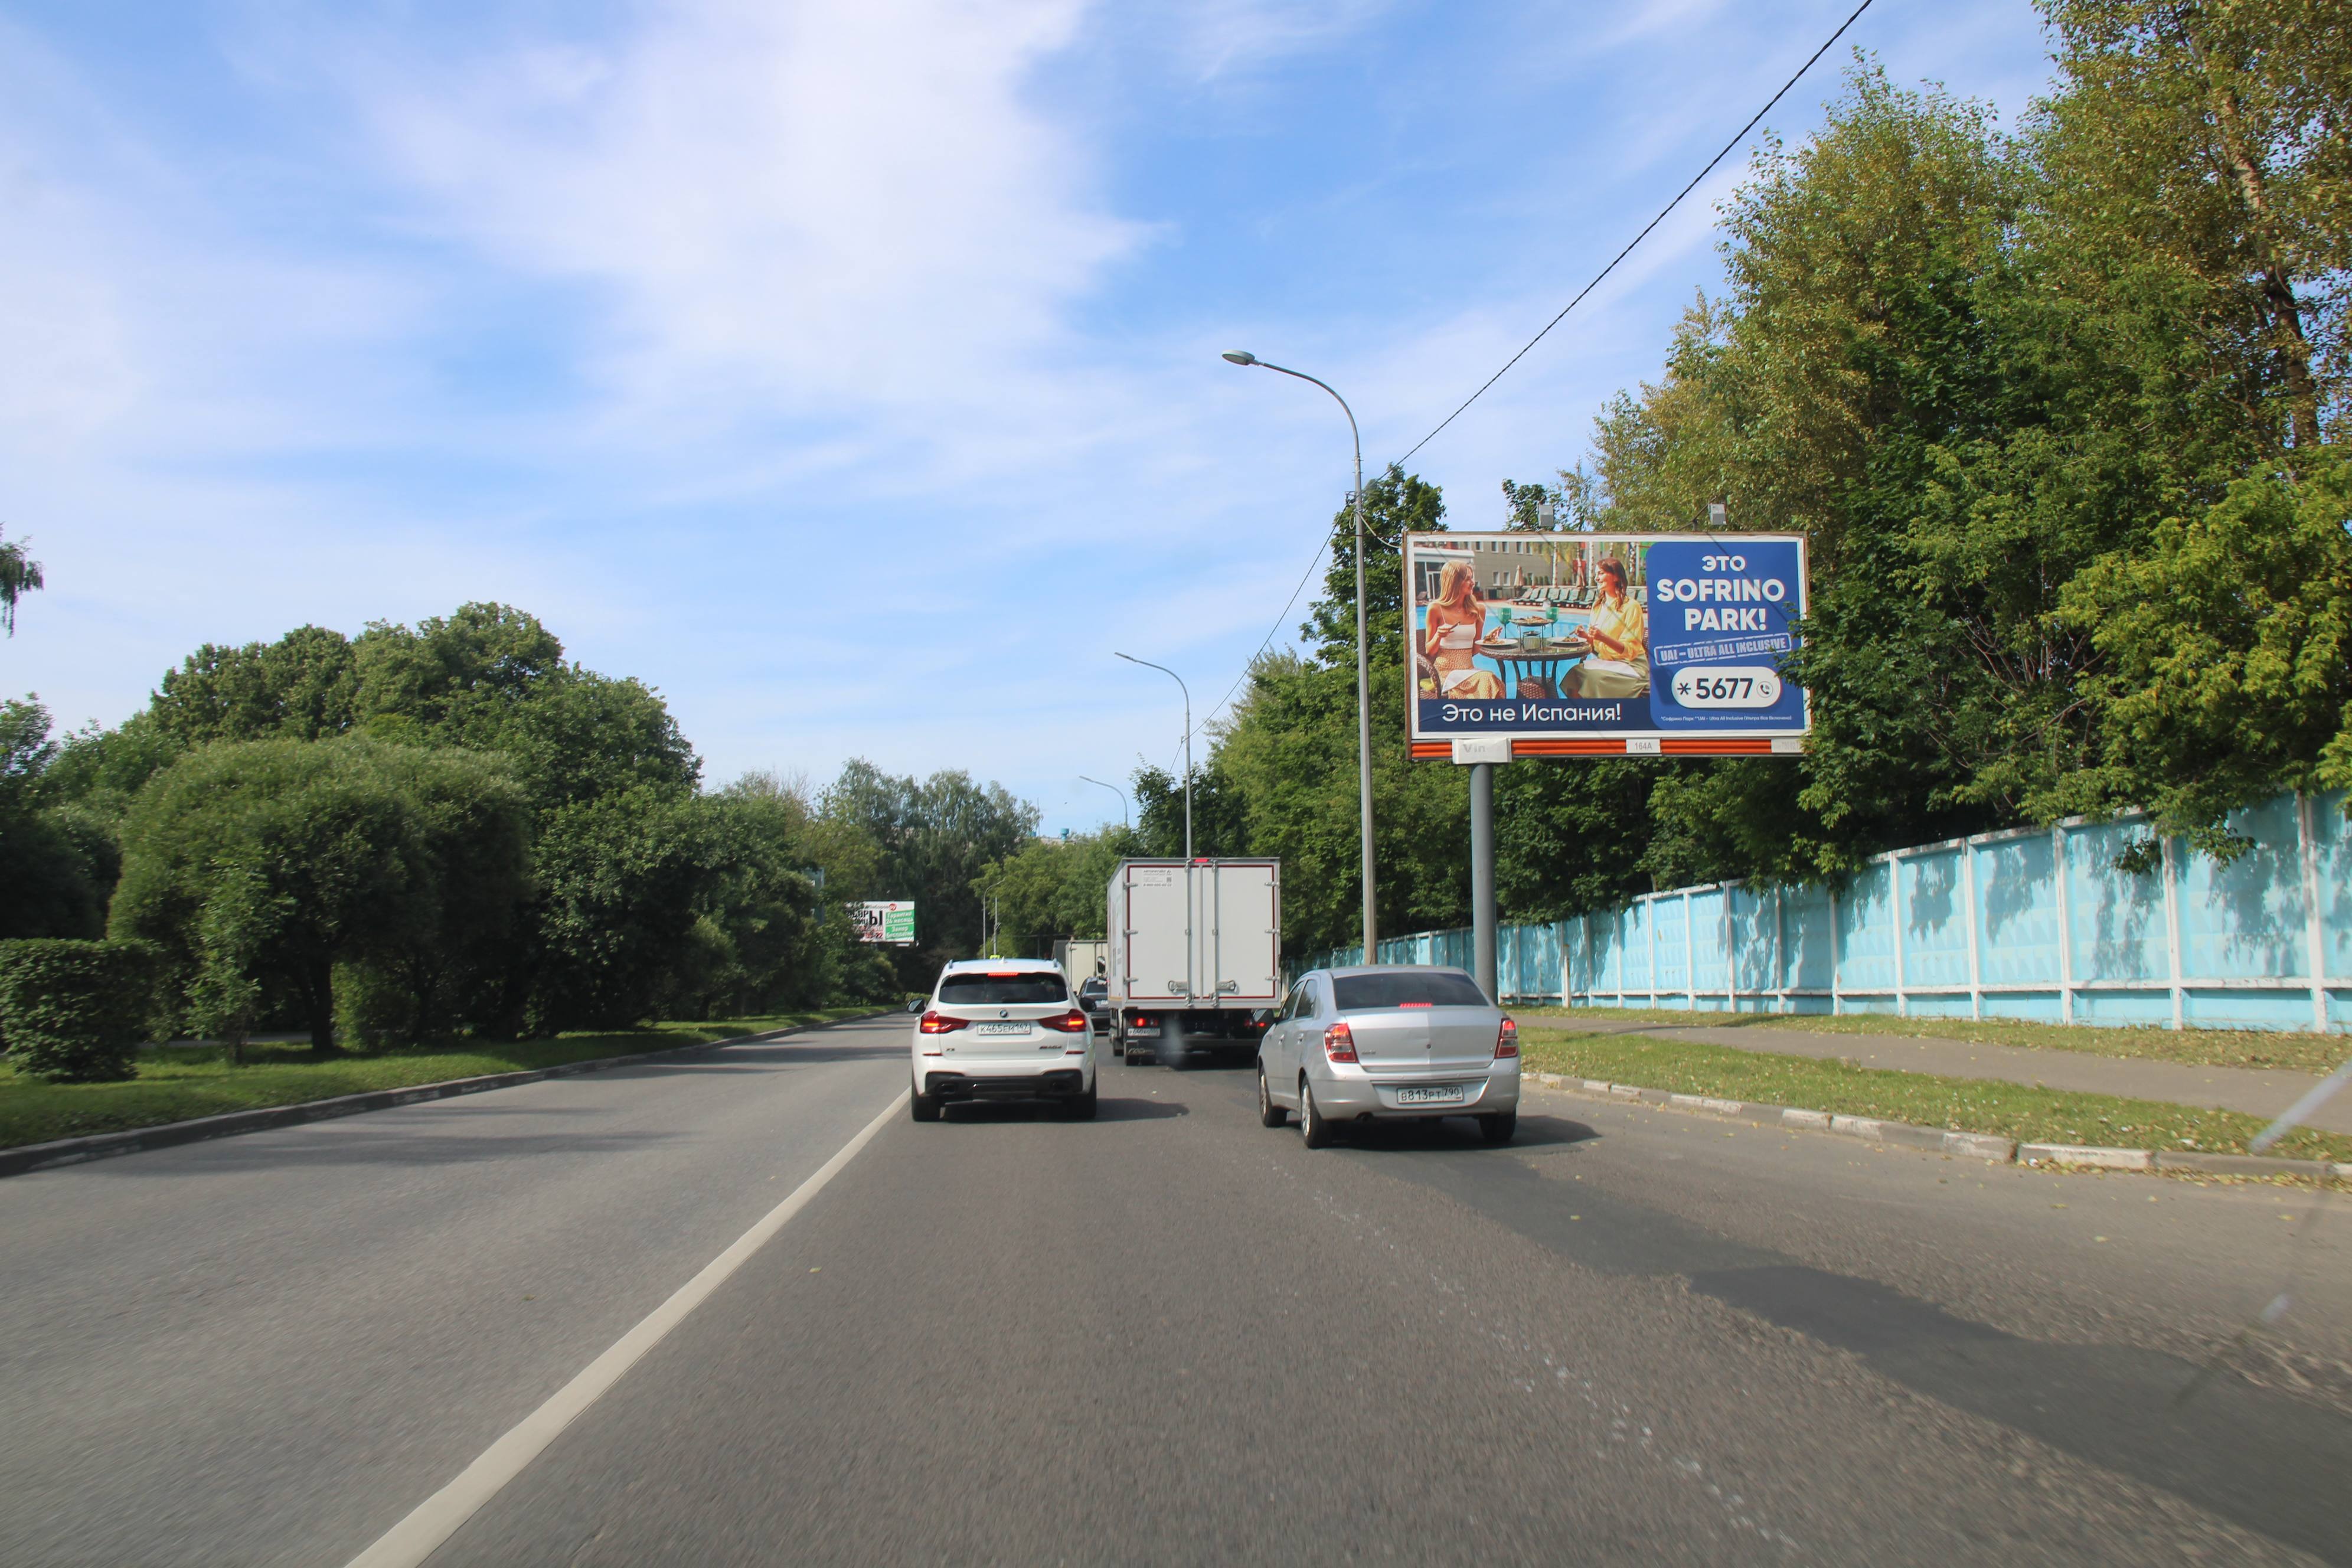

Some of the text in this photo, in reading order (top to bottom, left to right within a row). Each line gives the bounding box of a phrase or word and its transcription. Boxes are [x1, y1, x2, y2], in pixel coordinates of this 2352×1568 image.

[1701, 555, 1746, 571] ЭТО
[1657, 579, 1785, 602] SOFRINO
[1684, 608, 1766, 631] PARK!
[1660, 649, 1678, 662] UAI
[1687, 645, 1717, 659] ULTRA
[1719, 643, 1735, 655] ALL
[1736, 638, 1786, 654] INCLUSIVE
[1442, 703, 1621, 722] Это не Испания!
